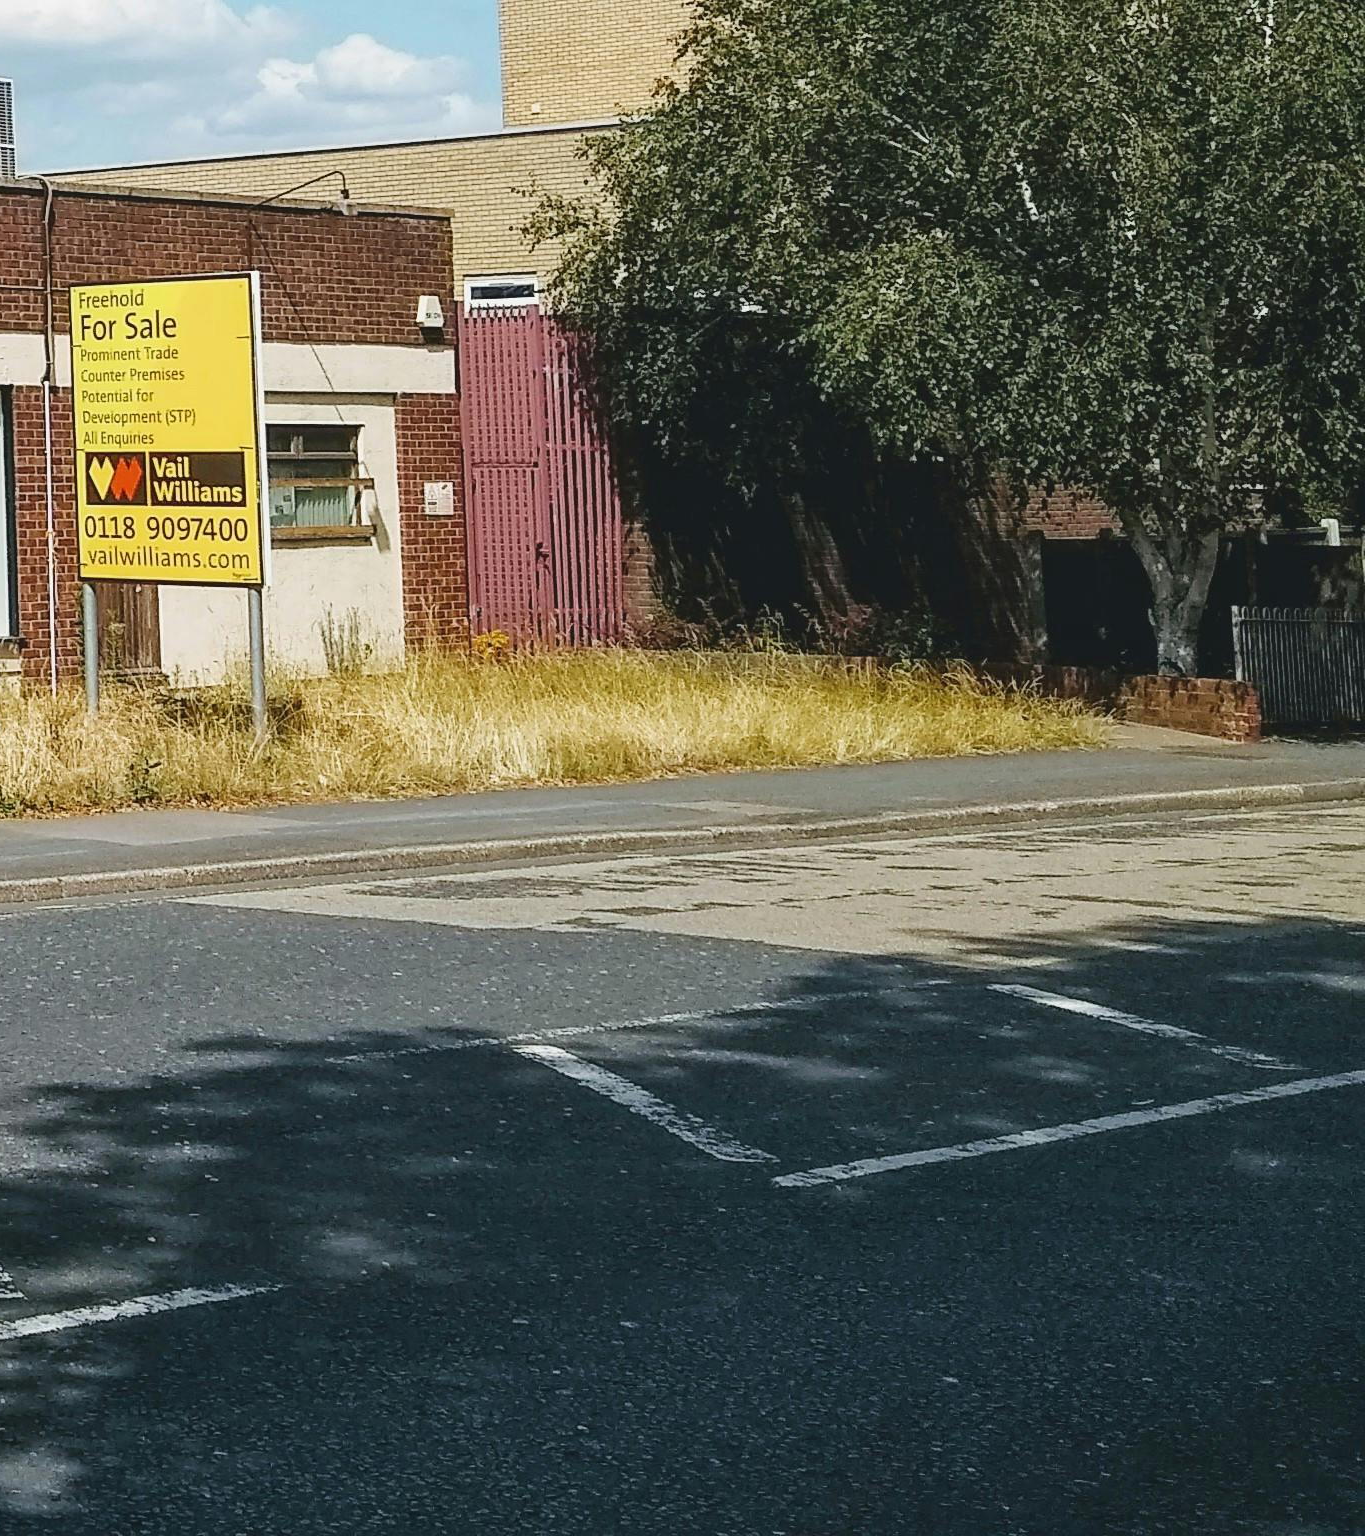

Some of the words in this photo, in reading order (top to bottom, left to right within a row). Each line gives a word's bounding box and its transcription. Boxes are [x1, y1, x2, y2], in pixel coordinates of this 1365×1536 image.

[79, 288, 144, 309] Freehold
[81, 314, 117, 341] For
[125, 309, 177, 340] Sale
[80, 348, 141, 362] Prominent
[144, 346, 179, 360] Trade
[81, 369, 126, 382] Counter
[130, 368, 185, 381] Premises
[81, 389, 133, 403] Potential
[136, 388, 154, 402] for
[82, 410, 162, 427] Development
[165, 408, 196, 426] (STP)
[83, 431, 98, 444] All
[101, 431, 154, 448] Enquiries
[152, 456, 190, 478] Vail
[153, 481, 243, 502] Williams
[85, 515, 135, 539] 0118
[147, 516, 248, 542] 9097400
[88, 546, 250, 569] vailwilliams.com
